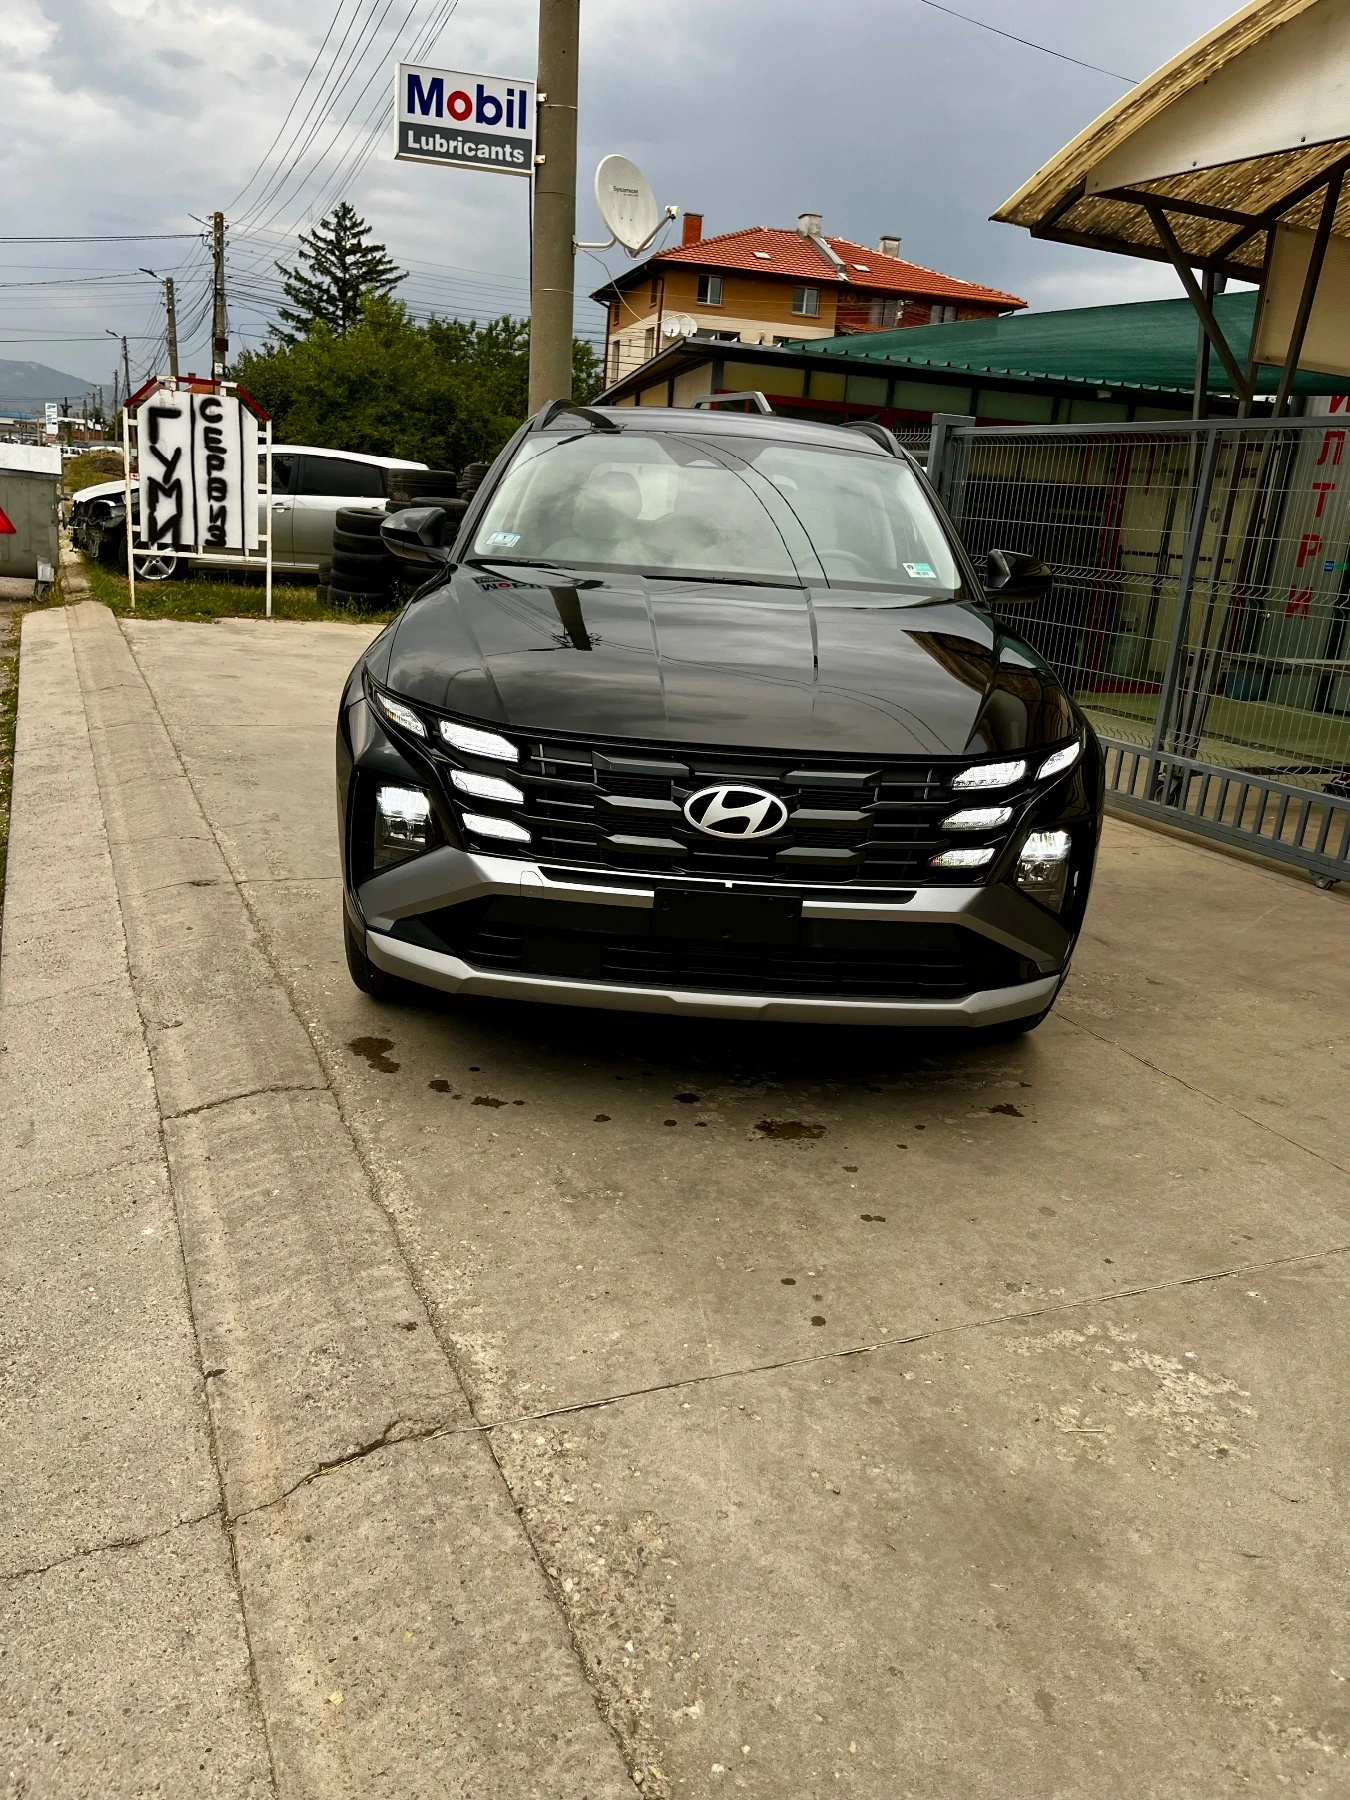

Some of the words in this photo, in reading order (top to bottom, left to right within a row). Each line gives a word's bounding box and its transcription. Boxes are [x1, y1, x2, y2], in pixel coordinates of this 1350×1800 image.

[407, 73, 527, 130] Mobil
[407, 130, 525, 163] Lubricants
[148, 407, 183, 552] ГУМИ
[200, 397, 228, 548] СЕРВИЗ
